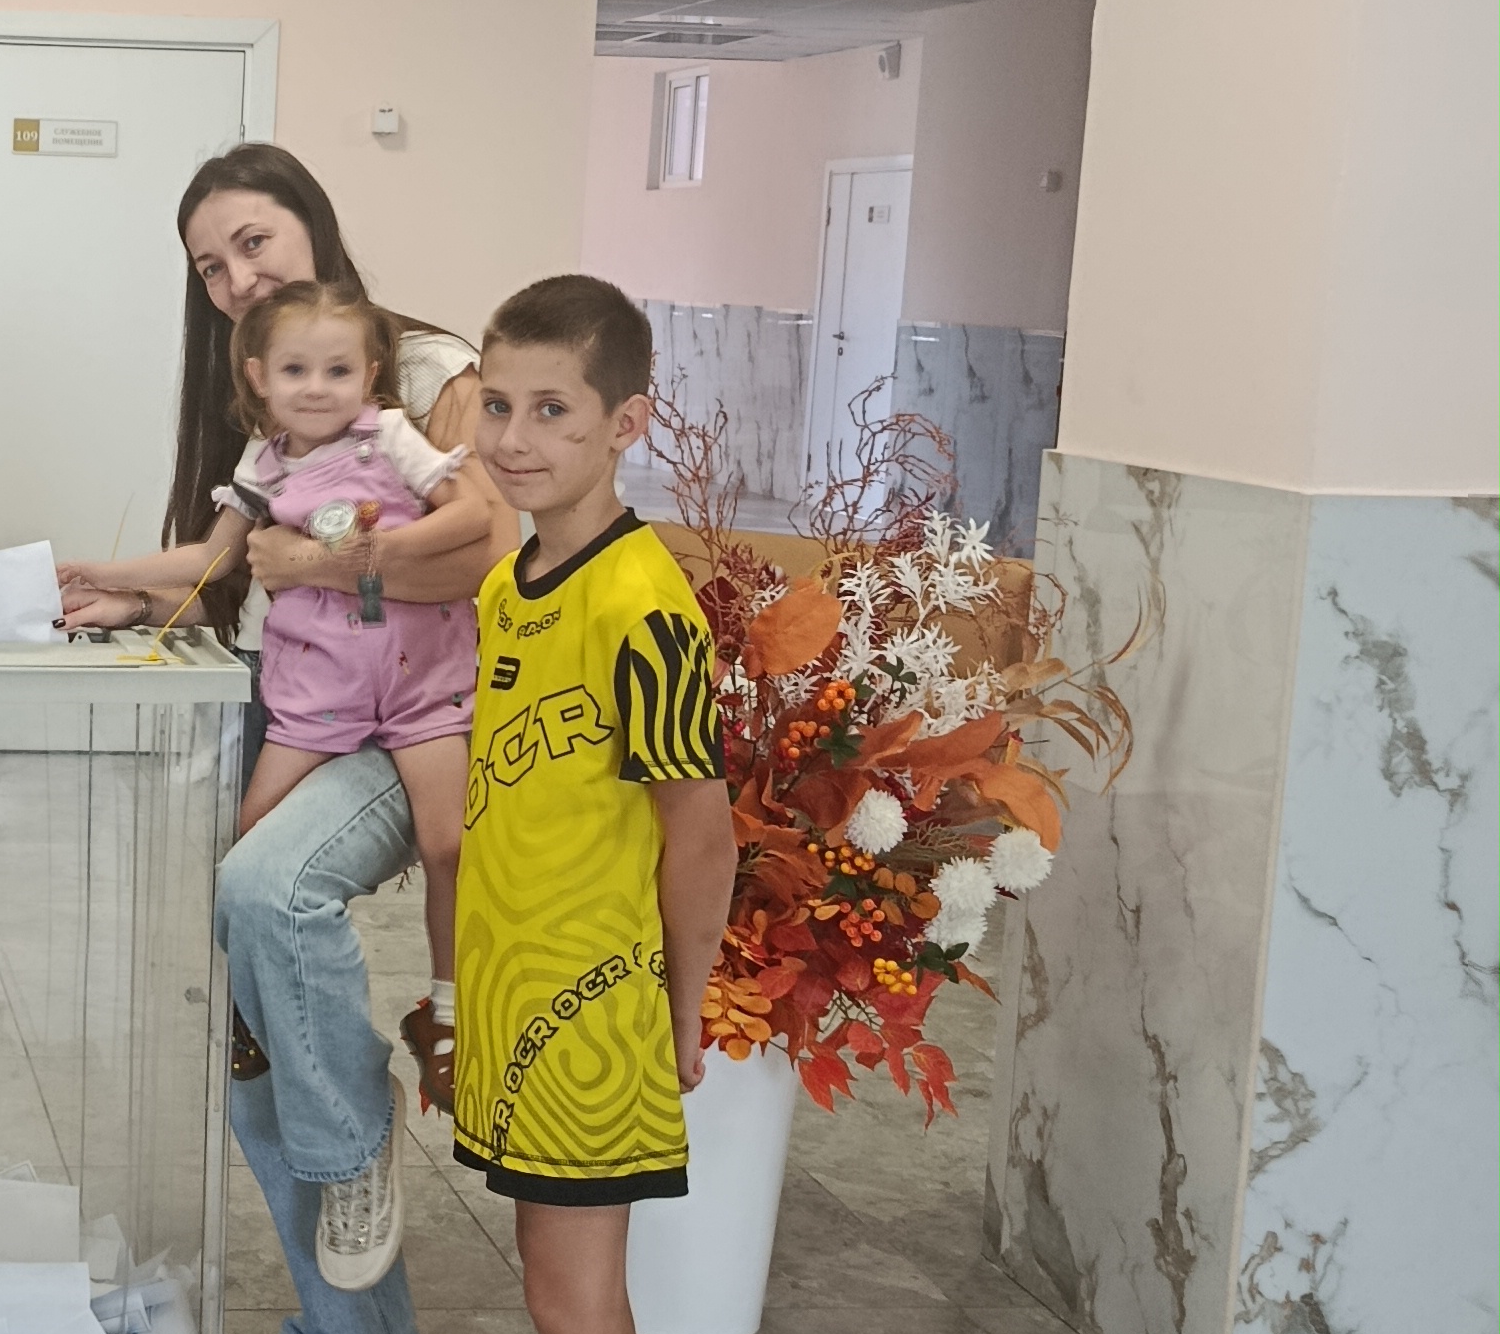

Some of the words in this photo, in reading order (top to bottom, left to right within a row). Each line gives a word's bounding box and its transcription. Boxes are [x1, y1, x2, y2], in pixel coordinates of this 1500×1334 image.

[16, 130, 38, 142] 109
[504, 1016, 560, 1094] OCR
[552, 955, 632, 1020] OCR
